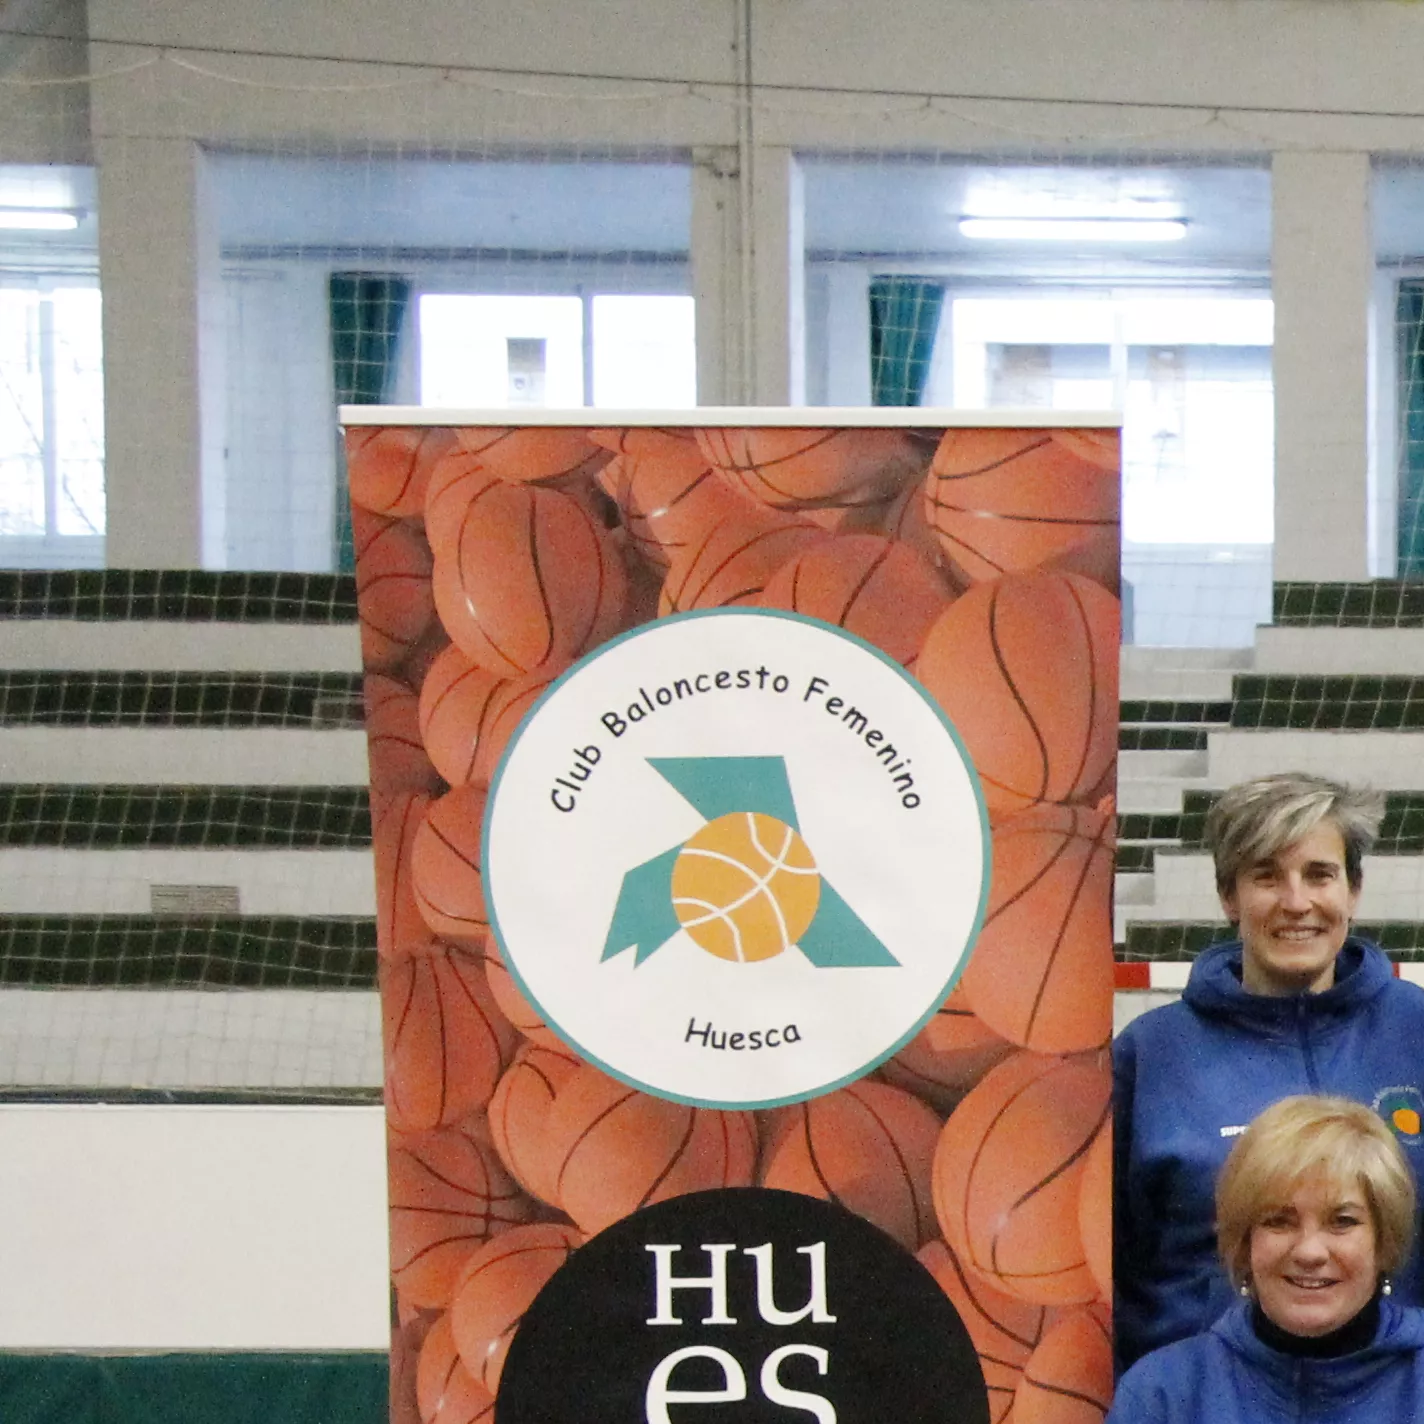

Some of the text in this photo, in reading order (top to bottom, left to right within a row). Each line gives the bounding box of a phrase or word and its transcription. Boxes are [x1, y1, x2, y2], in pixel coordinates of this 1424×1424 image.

[551, 666, 921, 813] Club Baloncesto Femenino
[684, 1017, 802, 1050] Huesca
[645, 1241, 837, 1326] Hu
